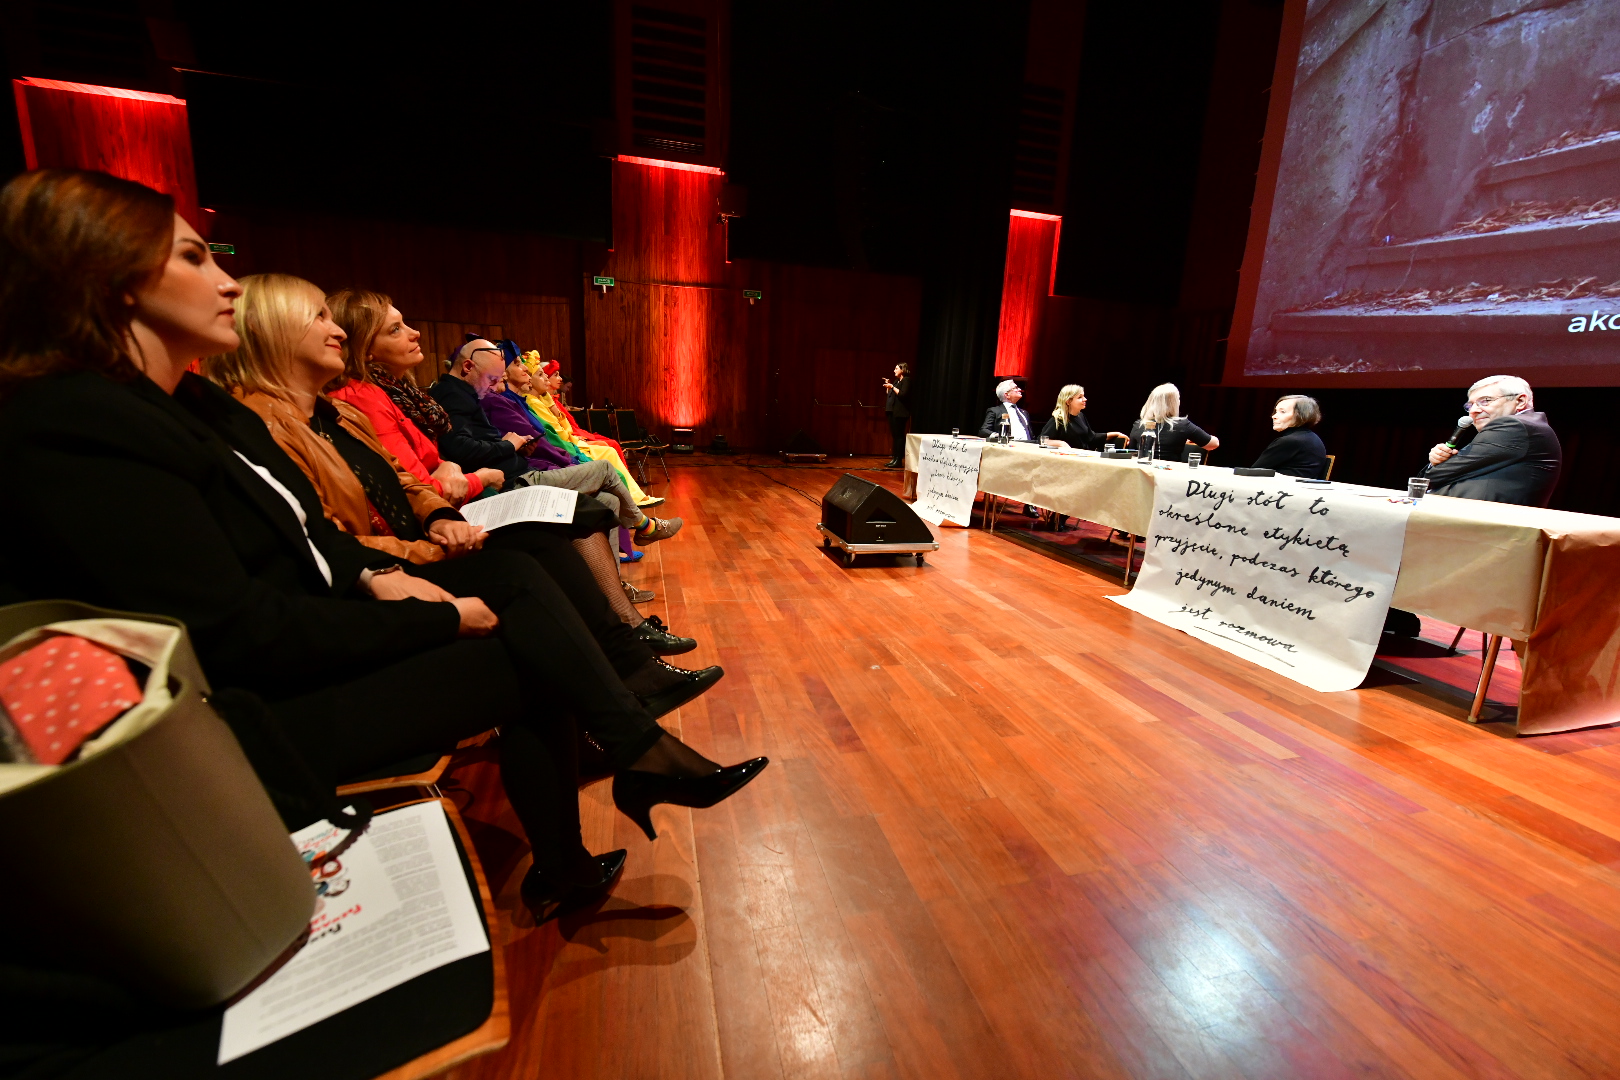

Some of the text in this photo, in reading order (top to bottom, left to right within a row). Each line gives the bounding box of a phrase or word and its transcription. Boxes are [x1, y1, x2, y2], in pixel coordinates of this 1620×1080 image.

[1186, 480, 1330, 516] Długi stół to
[1158, 505, 1350, 558] określone etykietą
[1174, 568, 1316, 621] jedynym daniem
[1229, 552, 1300, 577] podczas
[1307, 566, 1375, 603] którego
[1171, 603, 1299, 653] jest rozmowa
